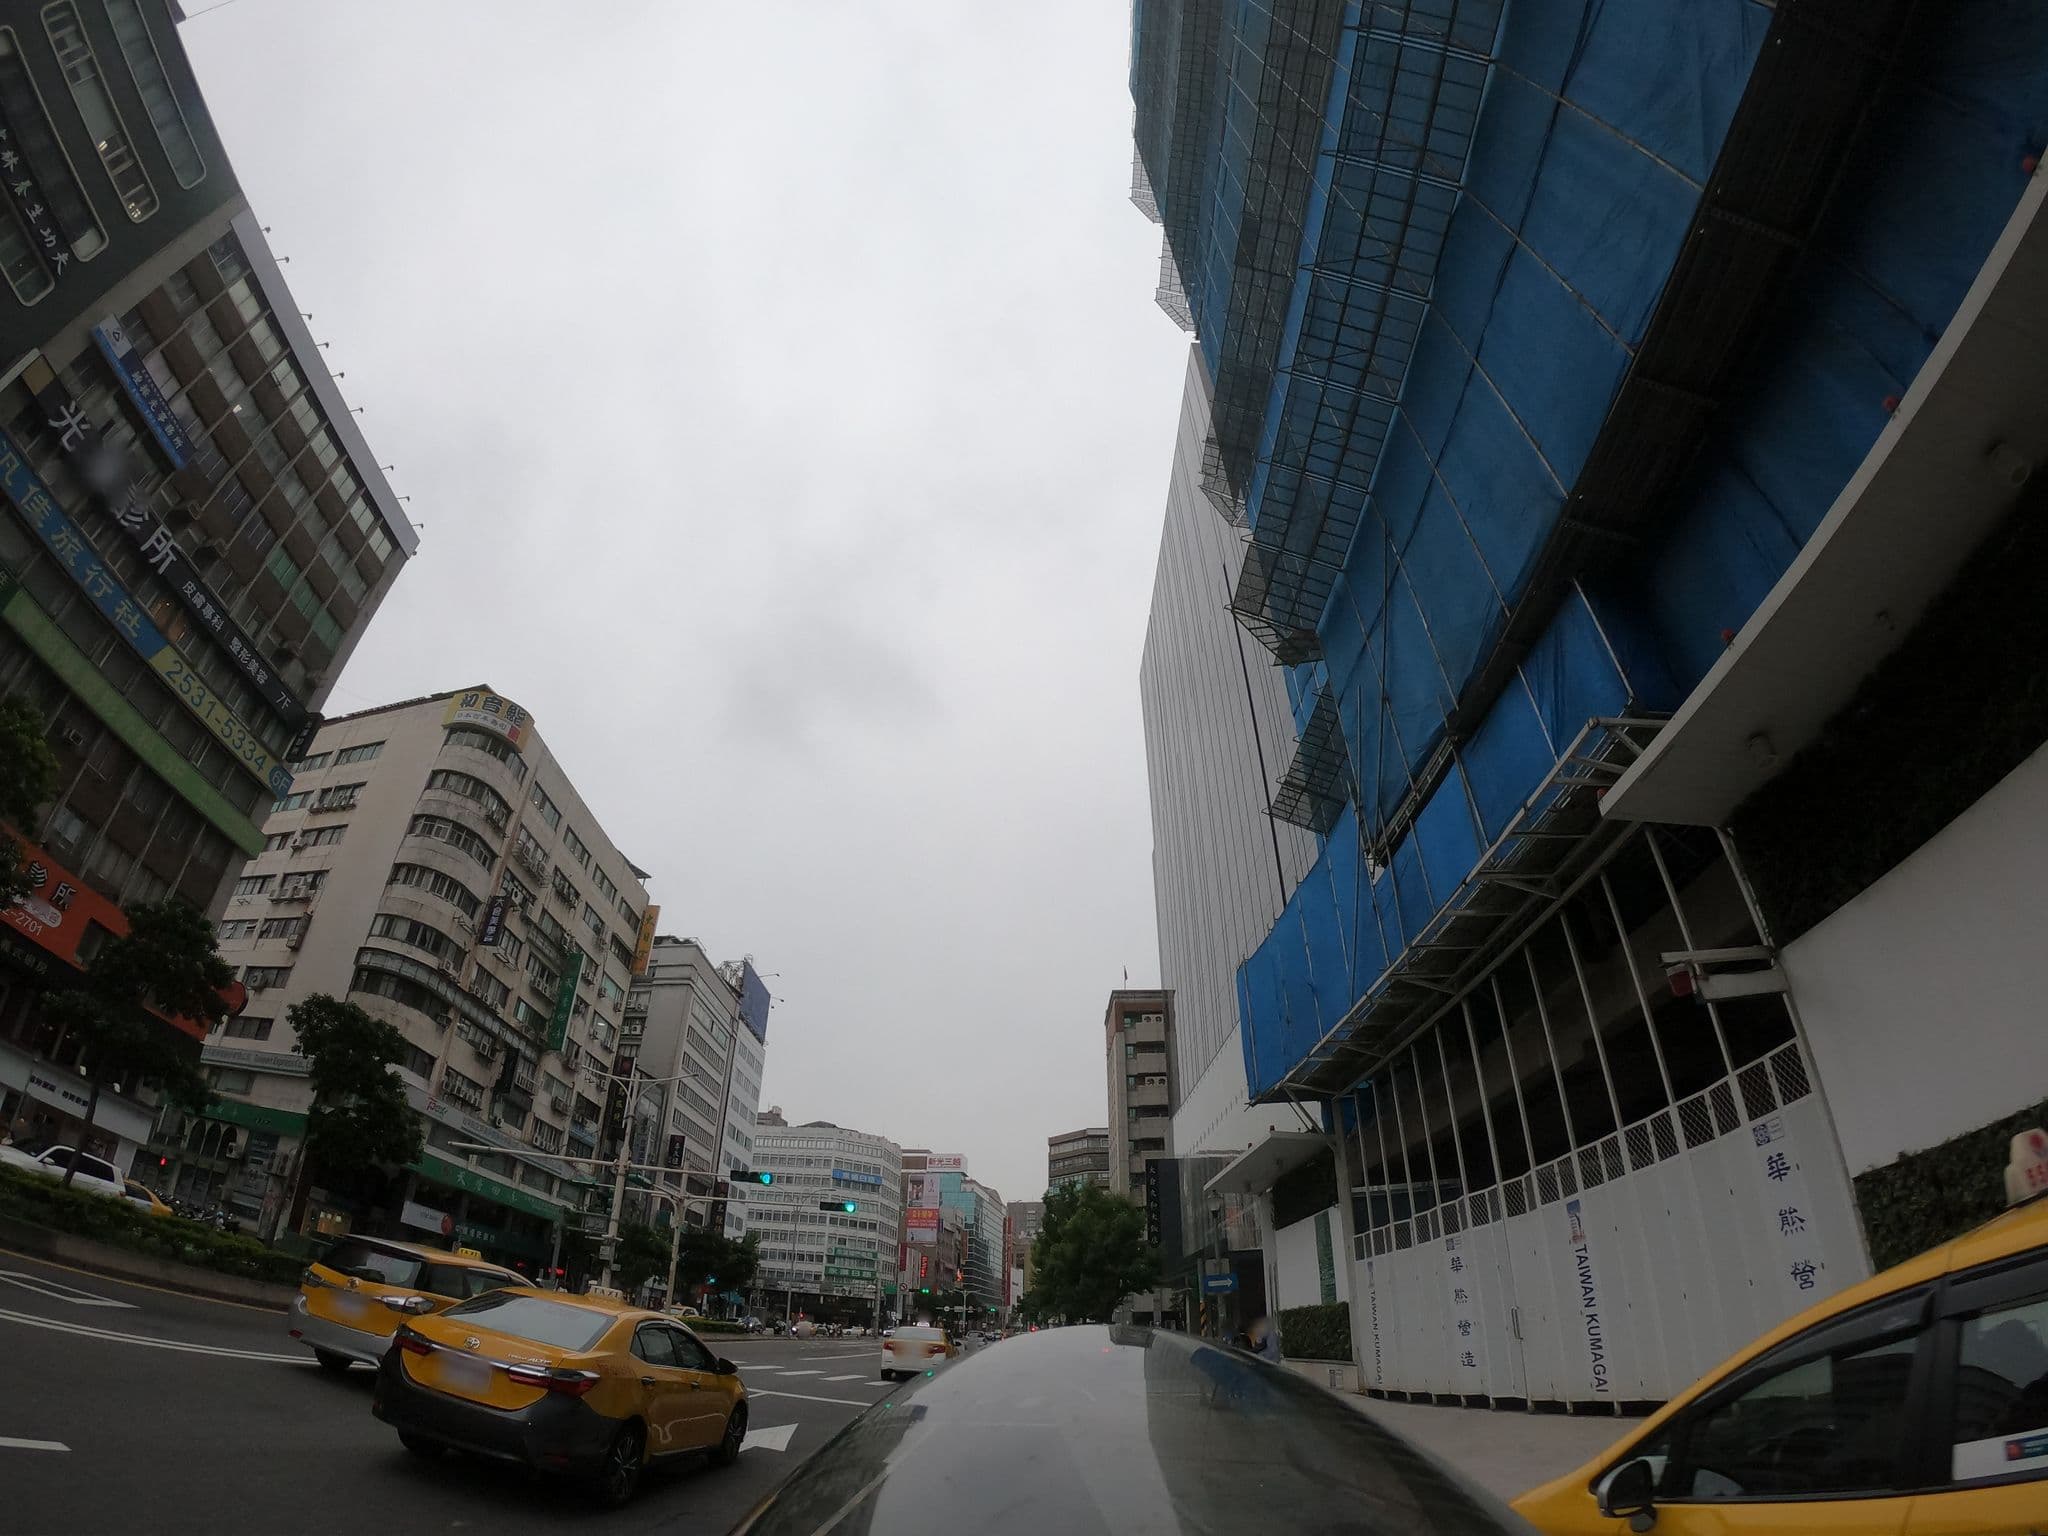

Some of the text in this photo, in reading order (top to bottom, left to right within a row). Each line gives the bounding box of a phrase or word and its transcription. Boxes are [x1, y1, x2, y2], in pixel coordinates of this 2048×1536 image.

[48, 400, 182, 575] 光診所
[275, 693, 292, 710] 7F
[164, 659, 271, 772] 2531-5334
[928, 1157, 961, 1167] 新光三越
[1370, 1290, 1383, 1385] TAIWAN KUMAGAI
[1450, 1256, 1477, 1368] 華熊營造
[1574, 1244, 1609, 1393] TAIWAN KUMAGAI
